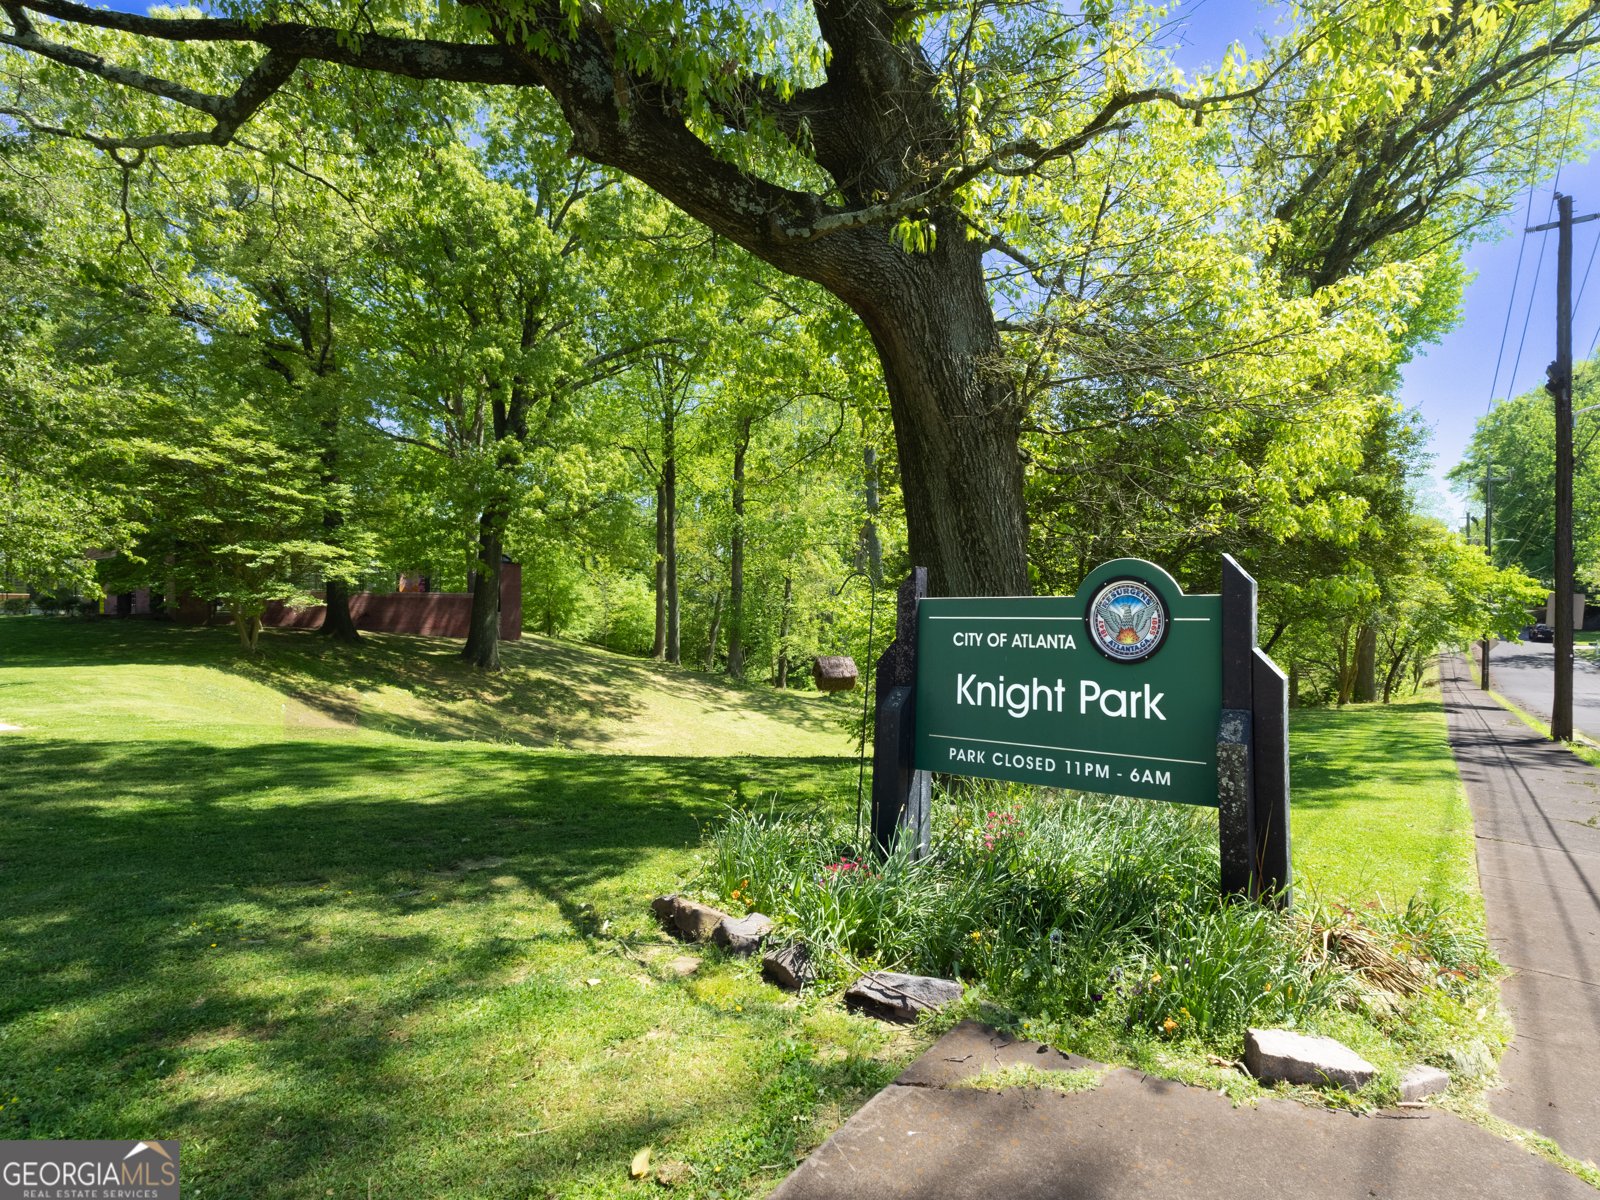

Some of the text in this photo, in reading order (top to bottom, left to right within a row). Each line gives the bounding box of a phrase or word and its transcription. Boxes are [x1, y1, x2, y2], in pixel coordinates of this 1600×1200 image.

[1102, 588, 1152, 608] RESURGENS
[953, 632, 1076, 650] CITY OF ATLANTA
[956, 673, 1167, 721] Knight Park
[949, 748, 985, 764] PARK
[992, 752, 1056, 772] CLOSED
[1065, 760, 1110, 779] 11PM
[1130, 768, 1171, 786] 6AM
